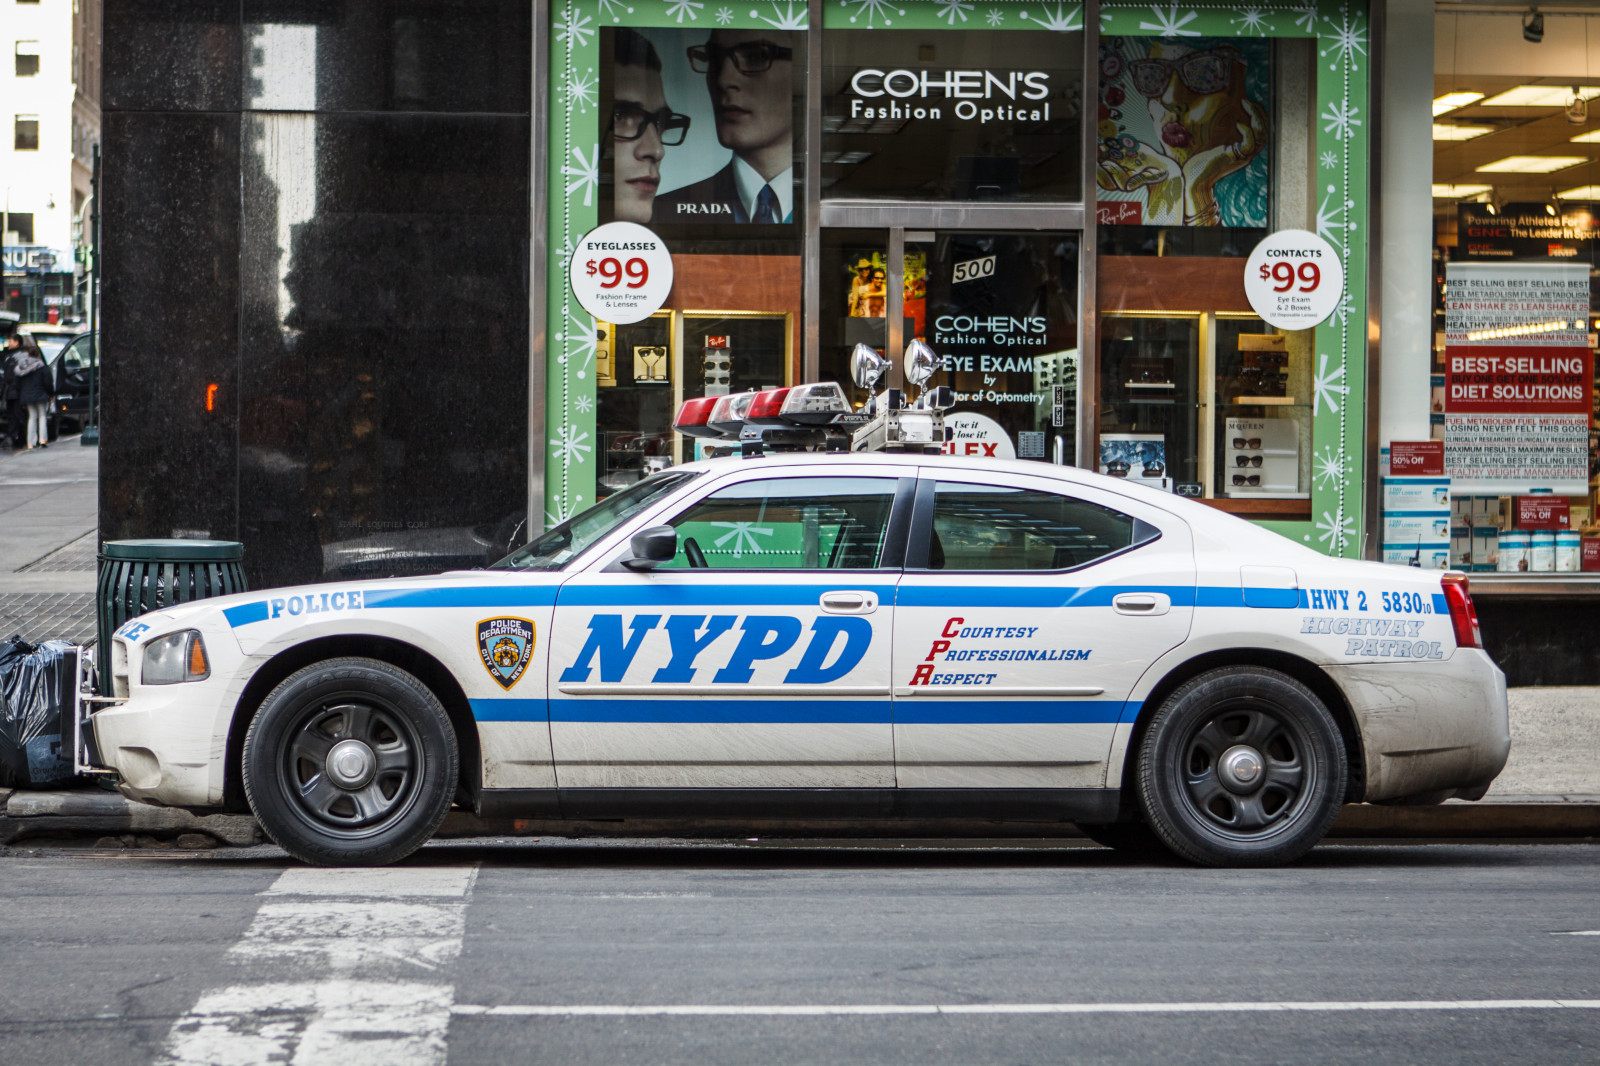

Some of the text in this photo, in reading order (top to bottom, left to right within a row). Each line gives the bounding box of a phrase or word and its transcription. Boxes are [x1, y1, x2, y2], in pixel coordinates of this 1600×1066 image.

[851, 69, 1050, 100] COHEN'S
[851, 100, 1049, 123] Fashion Optical
[676, 203, 732, 214] PRADA
[1096, 203, 1137, 225] Ray-Ban
[1467, 215, 1516, 227] Powering
[1519, 216, 1560, 226] Athletes
[1562, 215, 1578, 226] For
[1467, 228, 1508, 237] GNC
[1510, 229, 1528, 238] The
[1529, 228, 1563, 239] Leader
[1563, 228, 1573, 239] In
[587, 242, 656, 250] EYEGLASSES
[1266, 249, 1322, 257] CONTACTS
[586, 257, 649, 289] $99
[954, 258, 994, 281] 500
[1259, 261, 1321, 293] $99
[1446, 280, 1588, 288] BEST SELLING BEST SELLING BEST
[1446, 291, 1588, 299] FUEL METABOLISM FUEL METABOLISM
[1447, 303, 1588, 311] LEAN SHAKE 25 LEAN SHAKE 25
[935, 315, 1046, 333] COHEN'S
[935, 333, 1047, 347] Fashion Optical
[942, 355, 1044, 372] EYE EXAMS
[1452, 358, 1583, 373] BEST-SELLING
[983, 374, 997, 386] by
[1452, 375, 1582, 384] BUY ONE GET ONE 50% OFF
[972, 389, 984, 401] of
[986, 390, 1045, 405] Optometry
[1452, 385, 1583, 400] DIET SOLUTIONS
[954, 421, 979, 429] Use it
[957, 431, 988, 439] lose it!
[271, 590, 361, 618] POLICE
[1310, 589, 1431, 614] HWY 2 5830 10
[490, 619, 521, 629] POLICE
[941, 617, 1038, 638] COURTESY
[1300, 617, 1424, 637] HIGHWAY
[480, 627, 532, 640] DEPARTMENT
[558, 614, 873, 684] NYPD
[925, 640, 1092, 661] PROFESSIONALISM
[1345, 638, 1443, 659] PATROL
[481, 643, 532, 680] CITY OF NEW YORK
[908, 664, 997, 685] RESPECT
